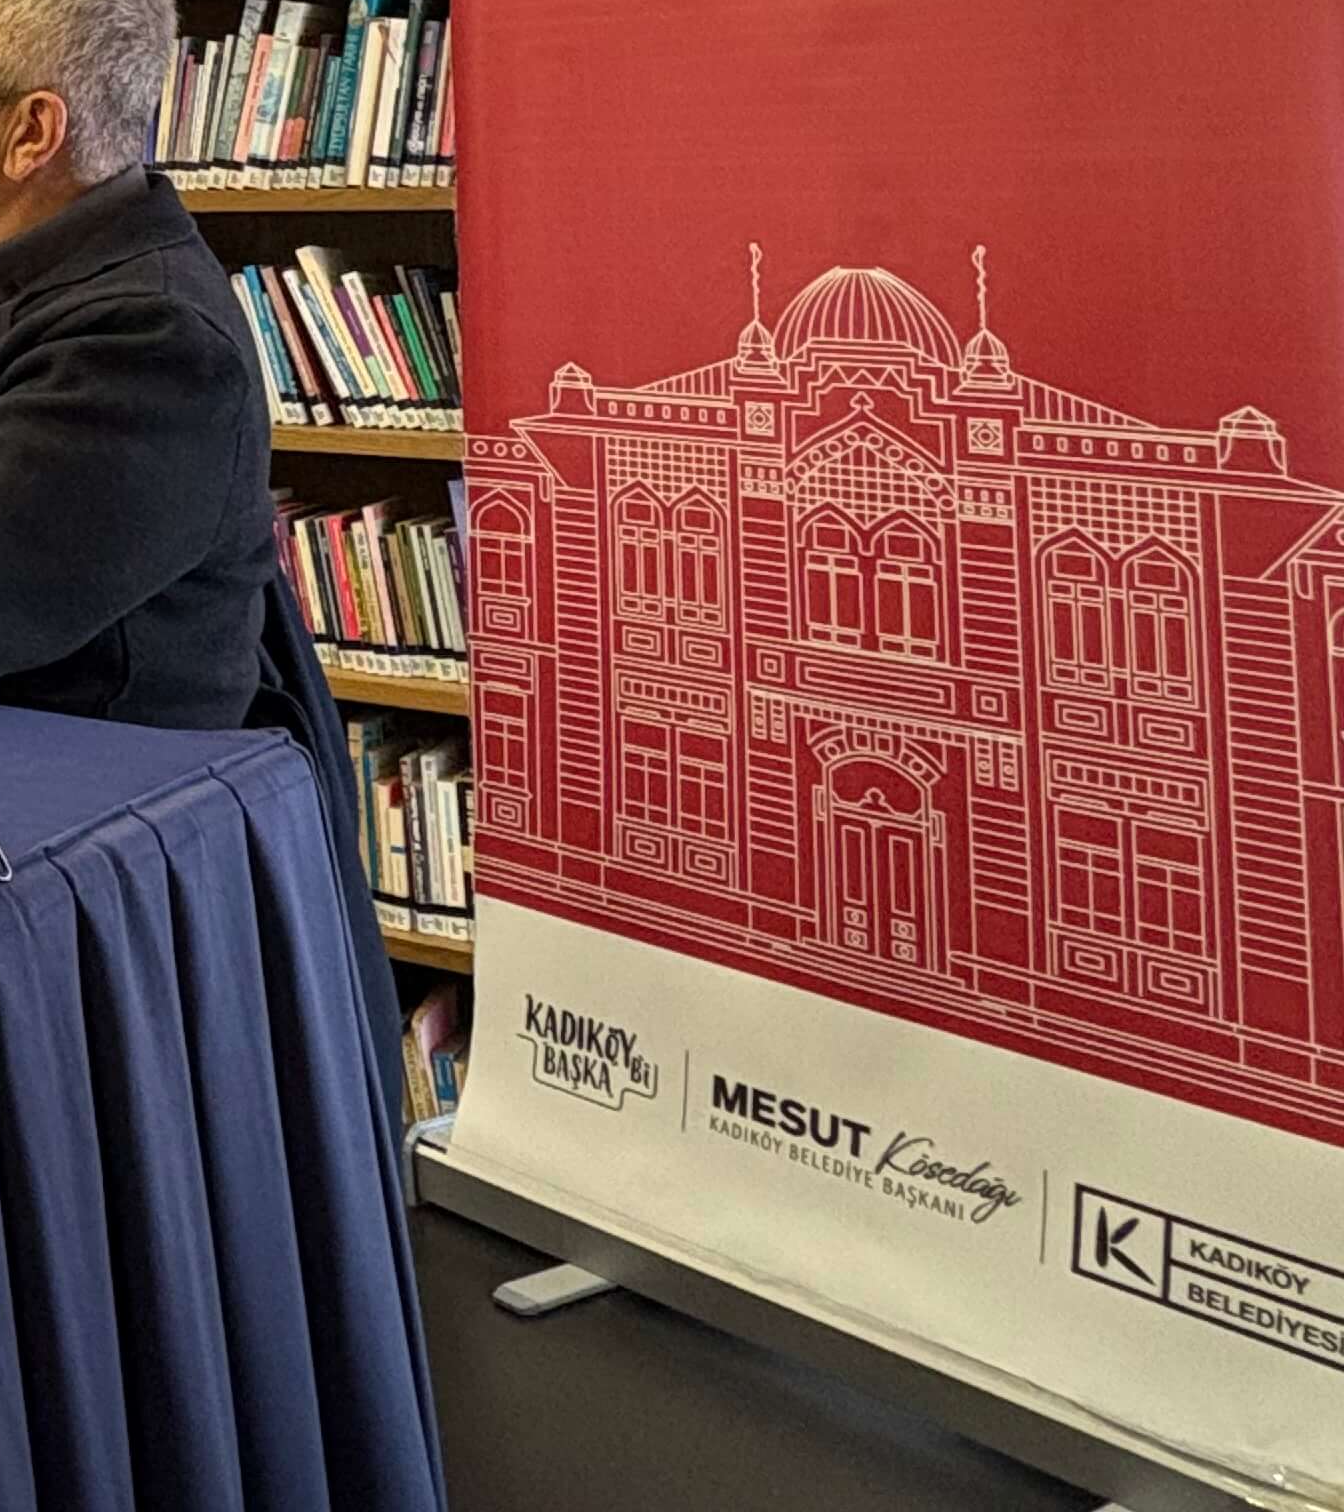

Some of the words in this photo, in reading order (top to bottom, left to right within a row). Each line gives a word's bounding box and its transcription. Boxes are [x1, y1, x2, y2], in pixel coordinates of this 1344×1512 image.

[525, 993, 637, 1069] KADIKÖY
[542, 1040, 614, 1099] BAŞKA
[709, 1114, 784, 1156] KADIKÖY
[787, 1143, 874, 1190] BELEDİYE
[881, 1176, 965, 1222] BAŞKANI
[712, 1073, 872, 1159] MESUT
[874, 1130, 1022, 1224] Kösedağı
[1189, 1238, 1311, 1296] KADIKÖY
